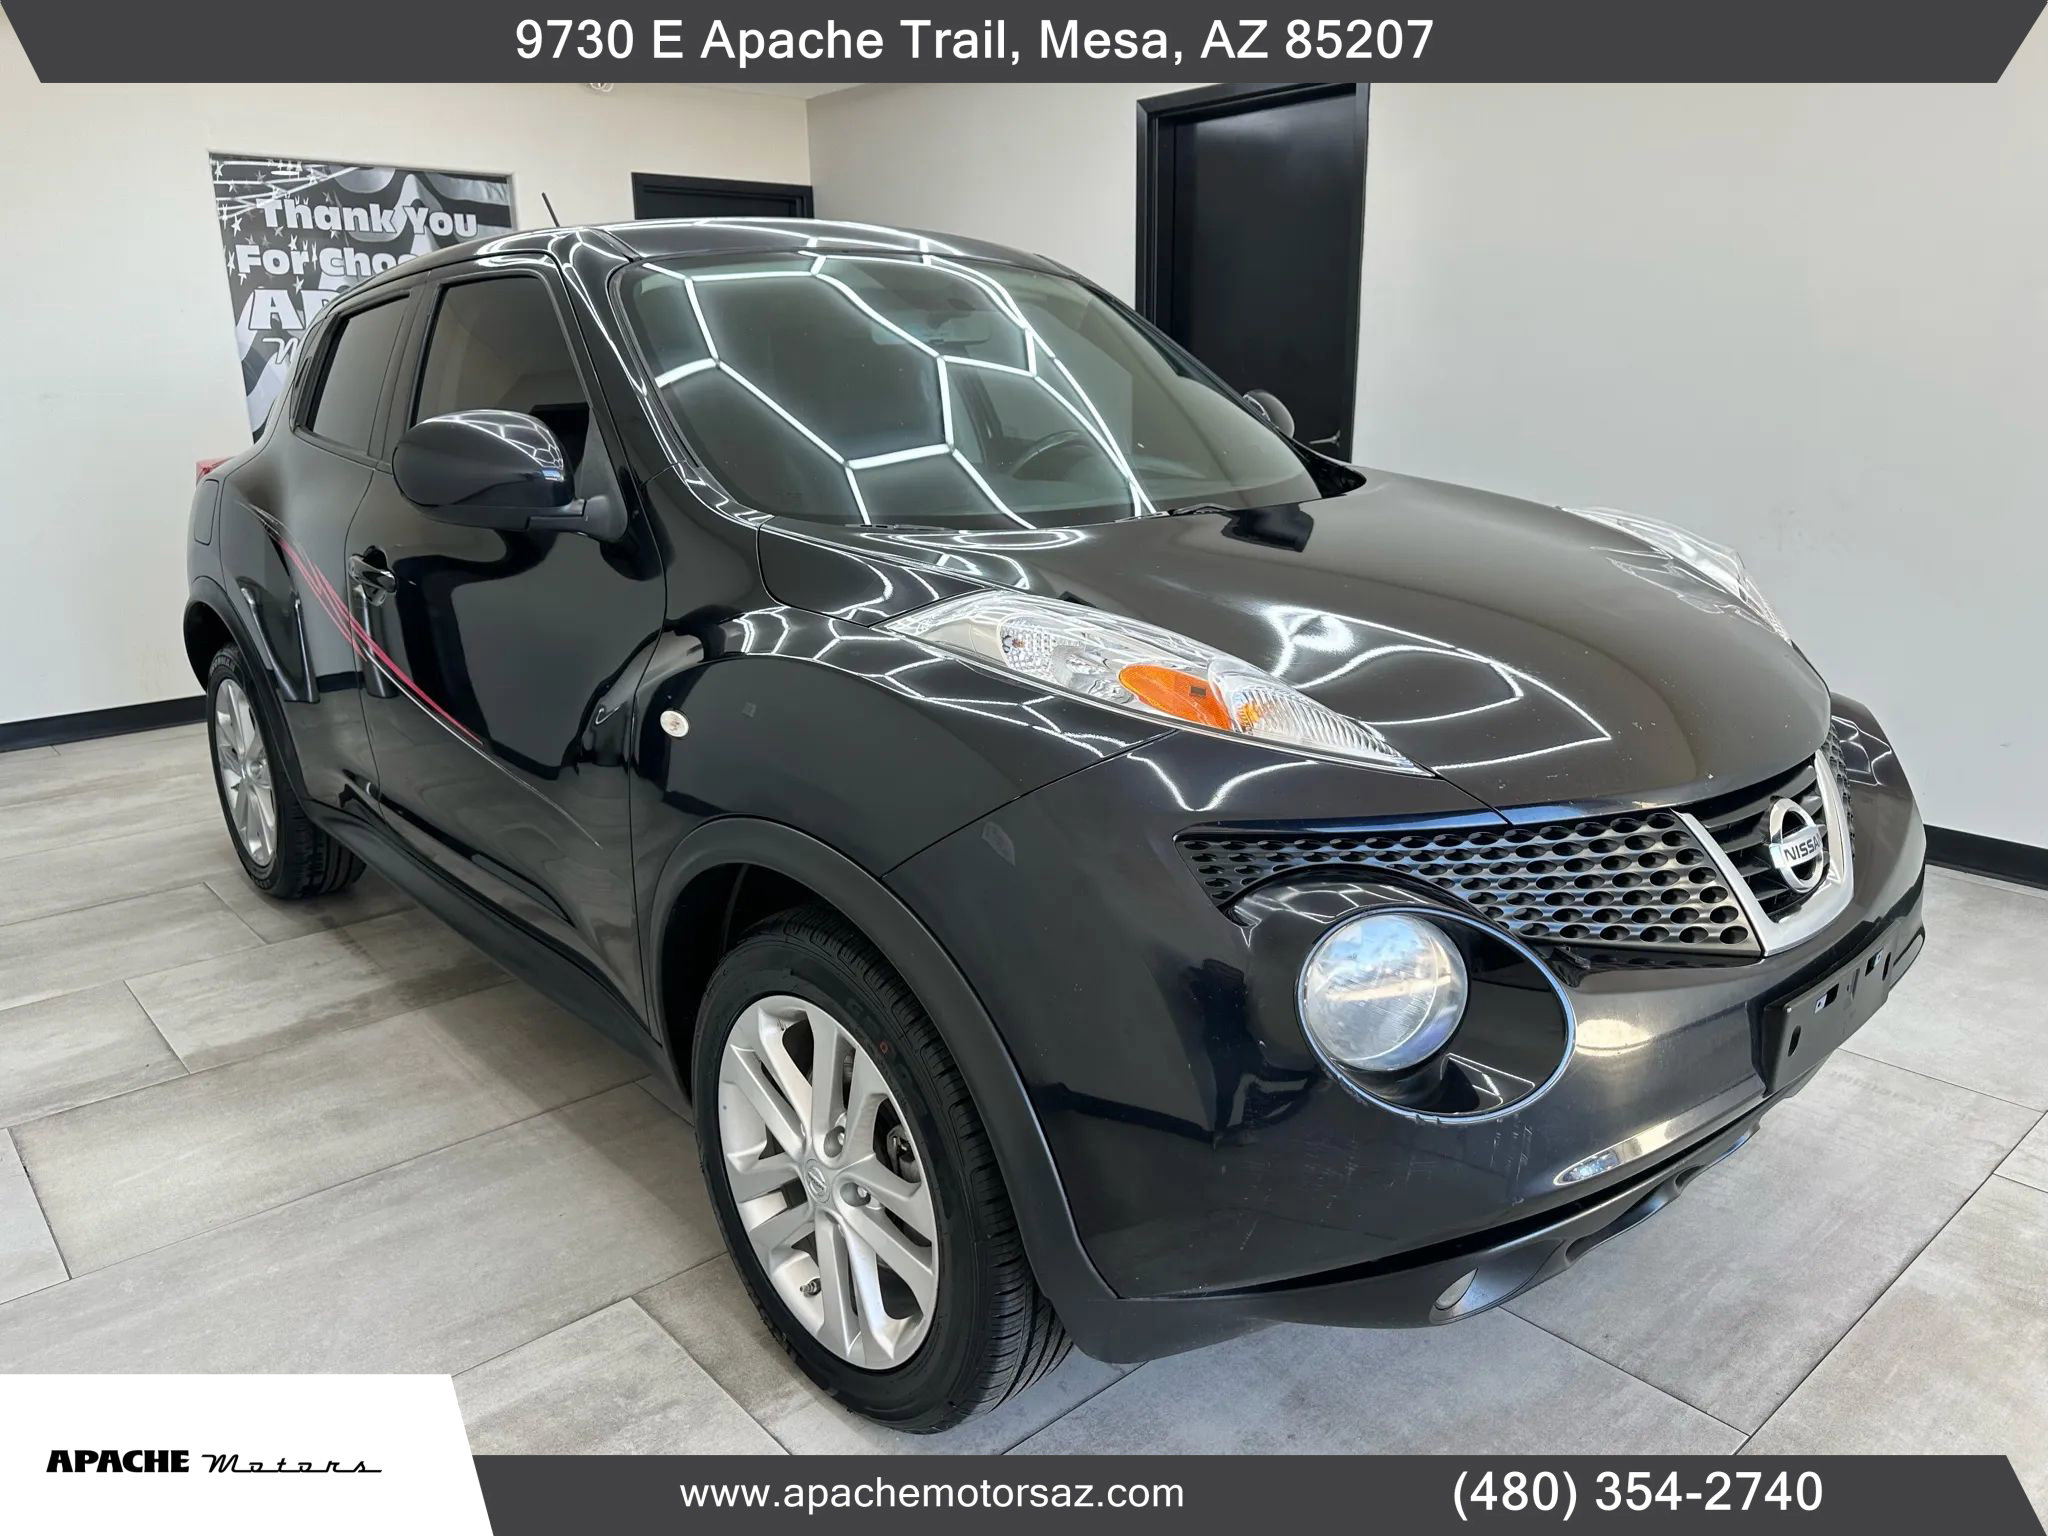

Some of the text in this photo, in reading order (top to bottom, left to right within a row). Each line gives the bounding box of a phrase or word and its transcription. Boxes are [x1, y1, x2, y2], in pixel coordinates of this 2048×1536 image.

[256, 198, 479, 238] Thank You
[235, 244, 309, 276] For
